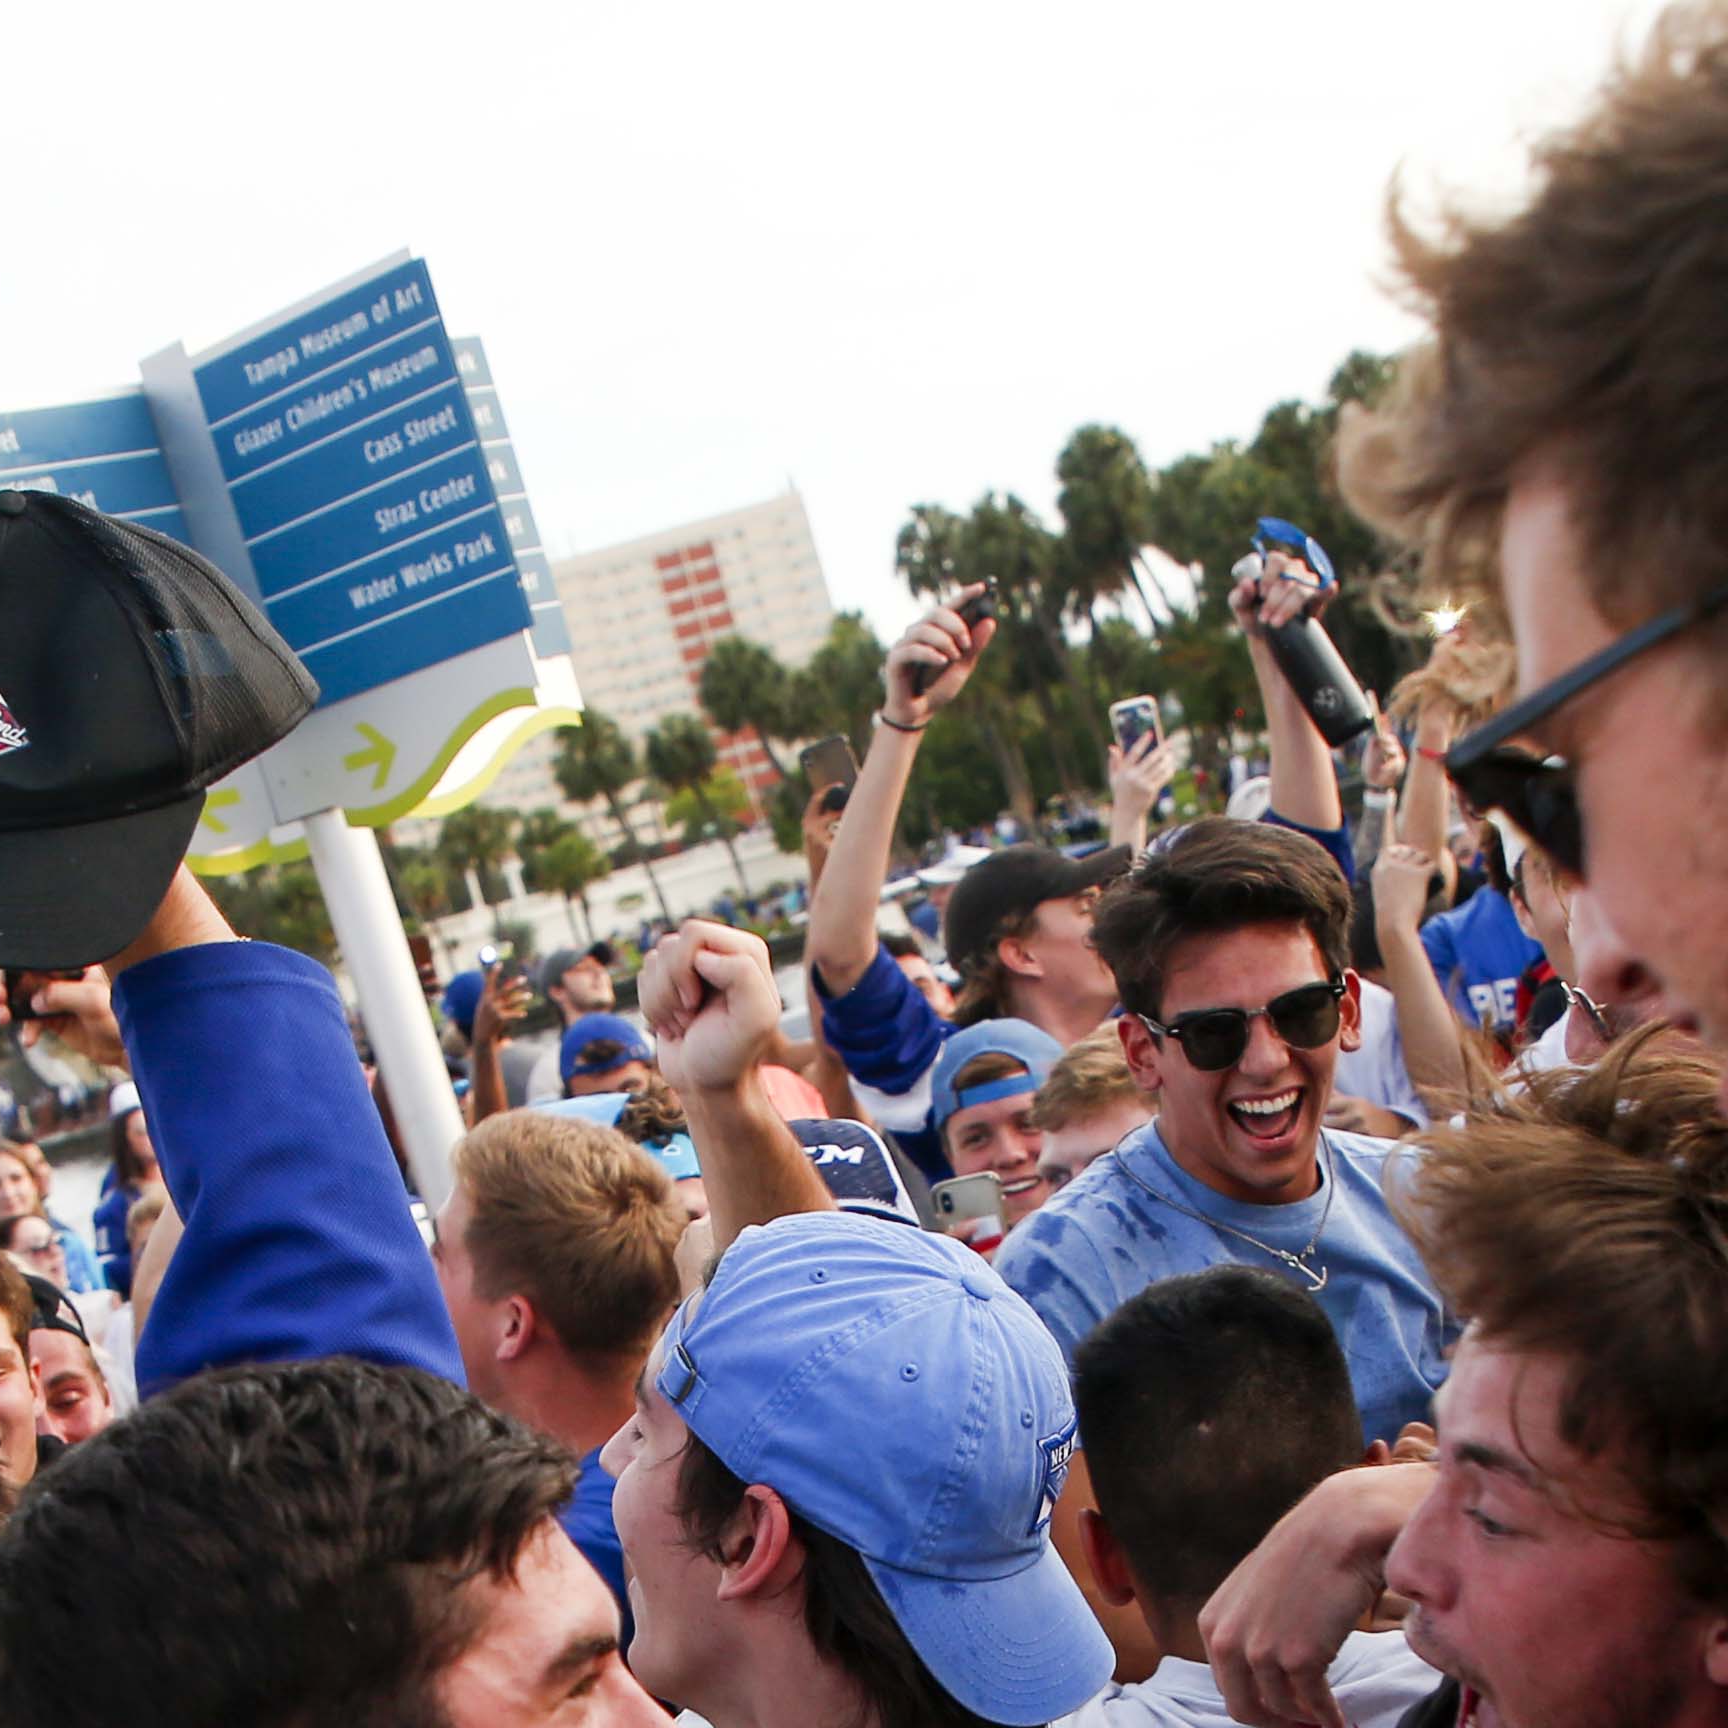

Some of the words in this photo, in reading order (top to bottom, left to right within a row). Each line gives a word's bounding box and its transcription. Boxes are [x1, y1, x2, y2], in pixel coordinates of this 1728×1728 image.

[243, 346, 299, 385] Tampa
[299, 311, 370, 359] Museum
[371, 294, 391, 324] of
[394, 281, 423, 315] Art
[233, 417, 284, 456] Glazer
[285, 377, 368, 432] Children's
[368, 345, 439, 393] Museum
[363, 431, 404, 464] Cass
[403, 404, 457, 447] Street
[374, 499, 418, 534] Straz
[418, 474, 476, 514] Center
[348, 574, 398, 609] Water
[399, 552, 453, 588] Works
[454, 531, 497, 566] Park
